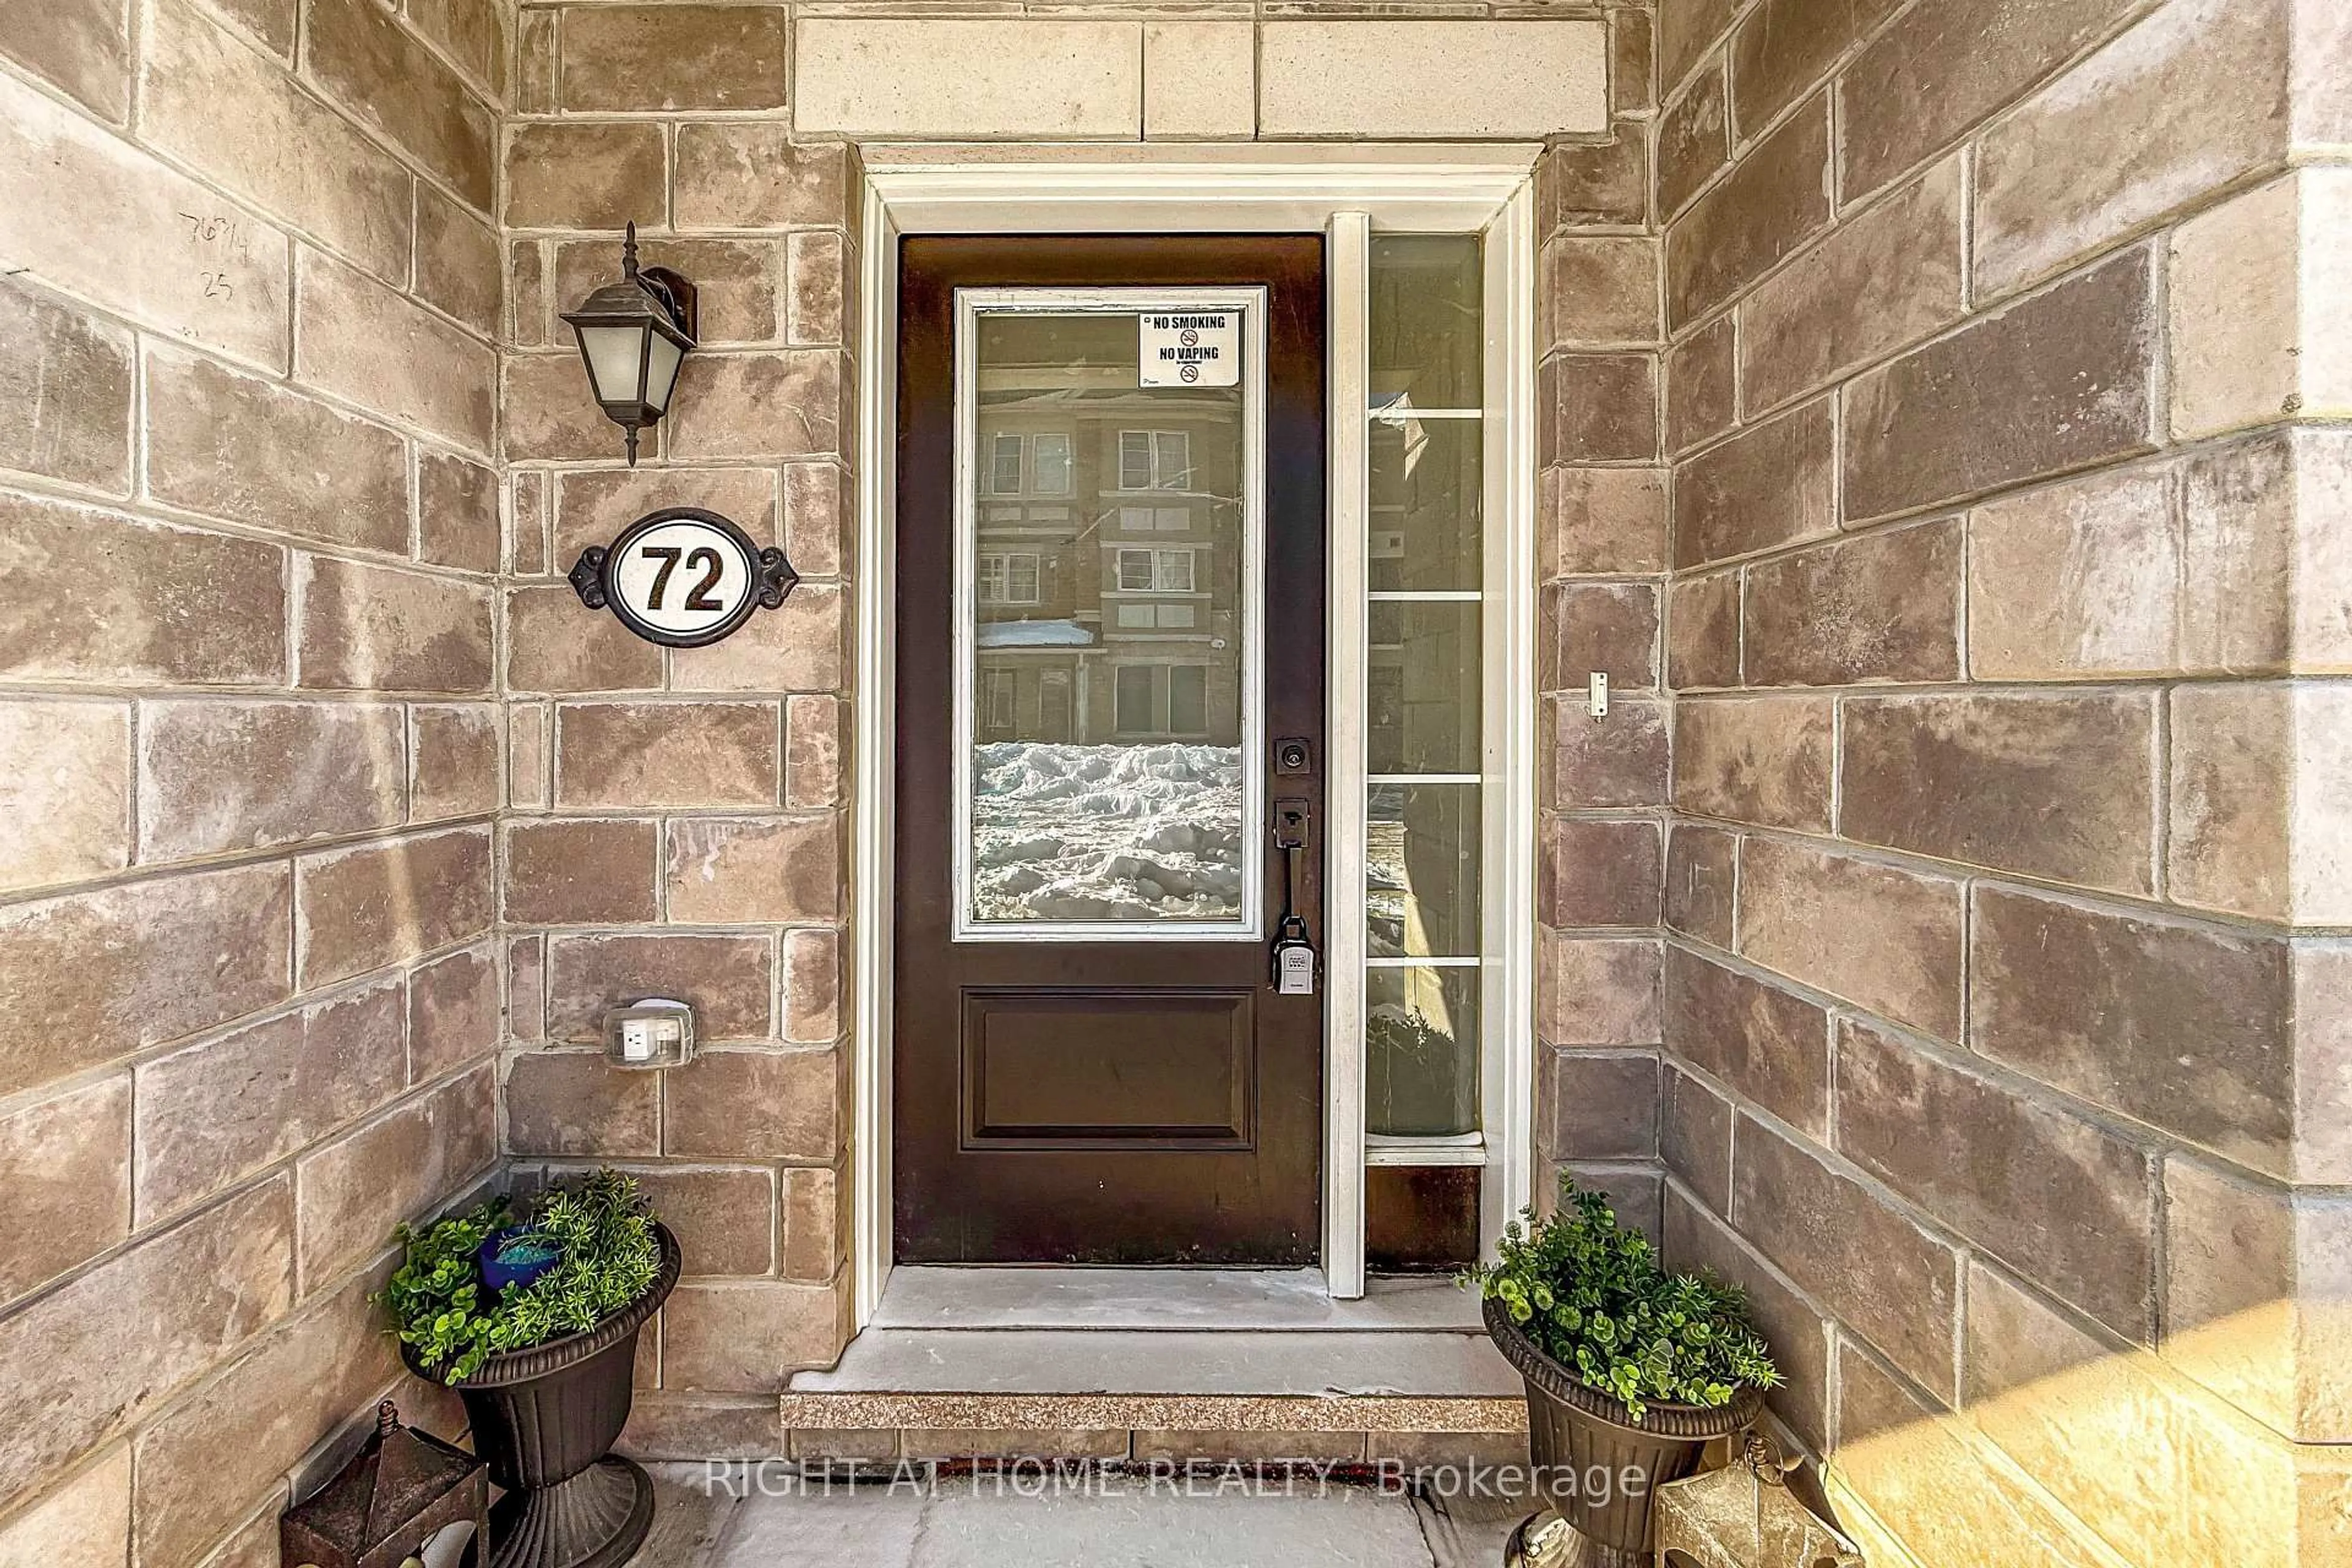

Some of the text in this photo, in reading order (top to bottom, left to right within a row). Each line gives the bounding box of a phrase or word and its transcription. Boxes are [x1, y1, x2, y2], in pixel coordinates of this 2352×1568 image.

[201, 271, 233, 301] 25
[1154, 316, 1225, 329] NO SMOKING
[1160, 347, 1219, 360] NO VAPING
[642, 546, 723, 611] 72
